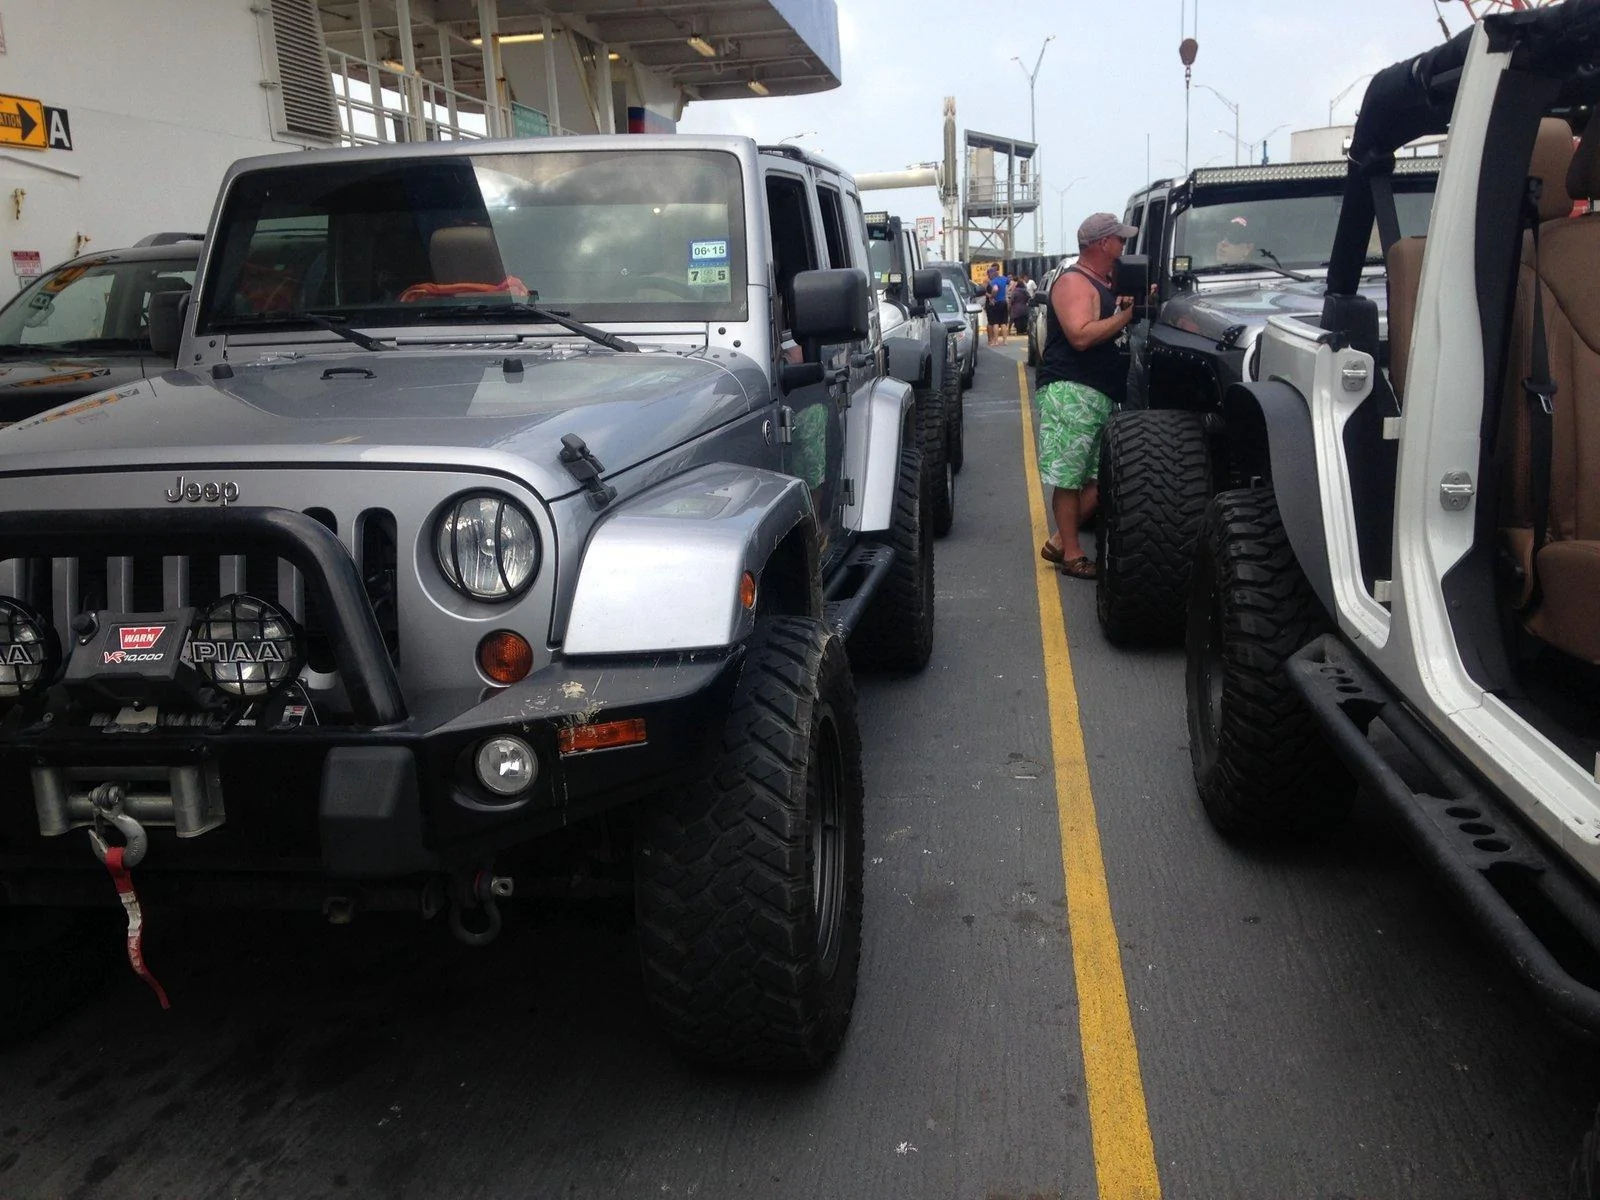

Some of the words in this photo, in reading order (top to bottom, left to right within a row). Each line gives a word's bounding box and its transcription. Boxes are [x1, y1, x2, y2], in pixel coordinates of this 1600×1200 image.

[50, 110, 70, 147] A
[164, 475, 240, 507] Jeep
[124, 633, 155, 643] WARN
[192, 641, 283, 663] PIAA
